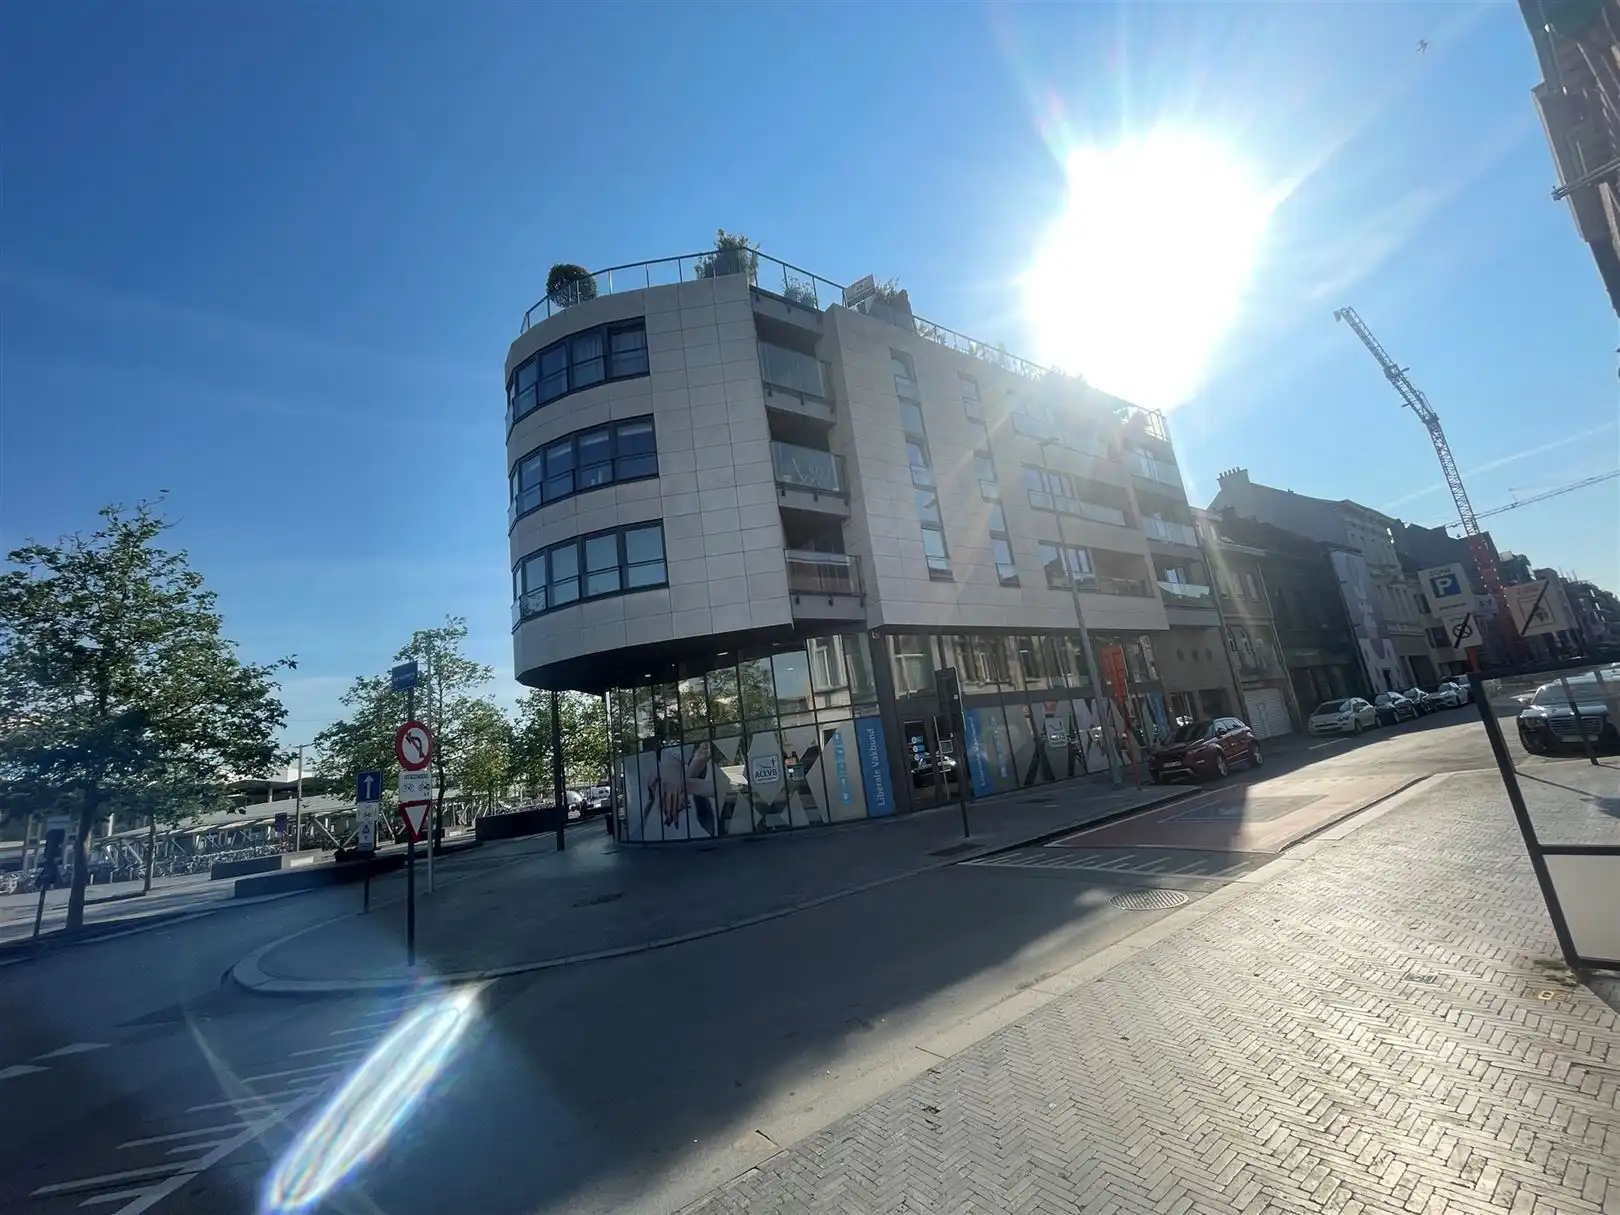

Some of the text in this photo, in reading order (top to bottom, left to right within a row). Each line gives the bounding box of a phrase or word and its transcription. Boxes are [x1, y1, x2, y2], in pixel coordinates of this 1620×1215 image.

[1436, 577, 1452, 596] P
[755, 768, 777, 778] ACLVB
[866, 728, 886, 806] Liberale Vakbond
